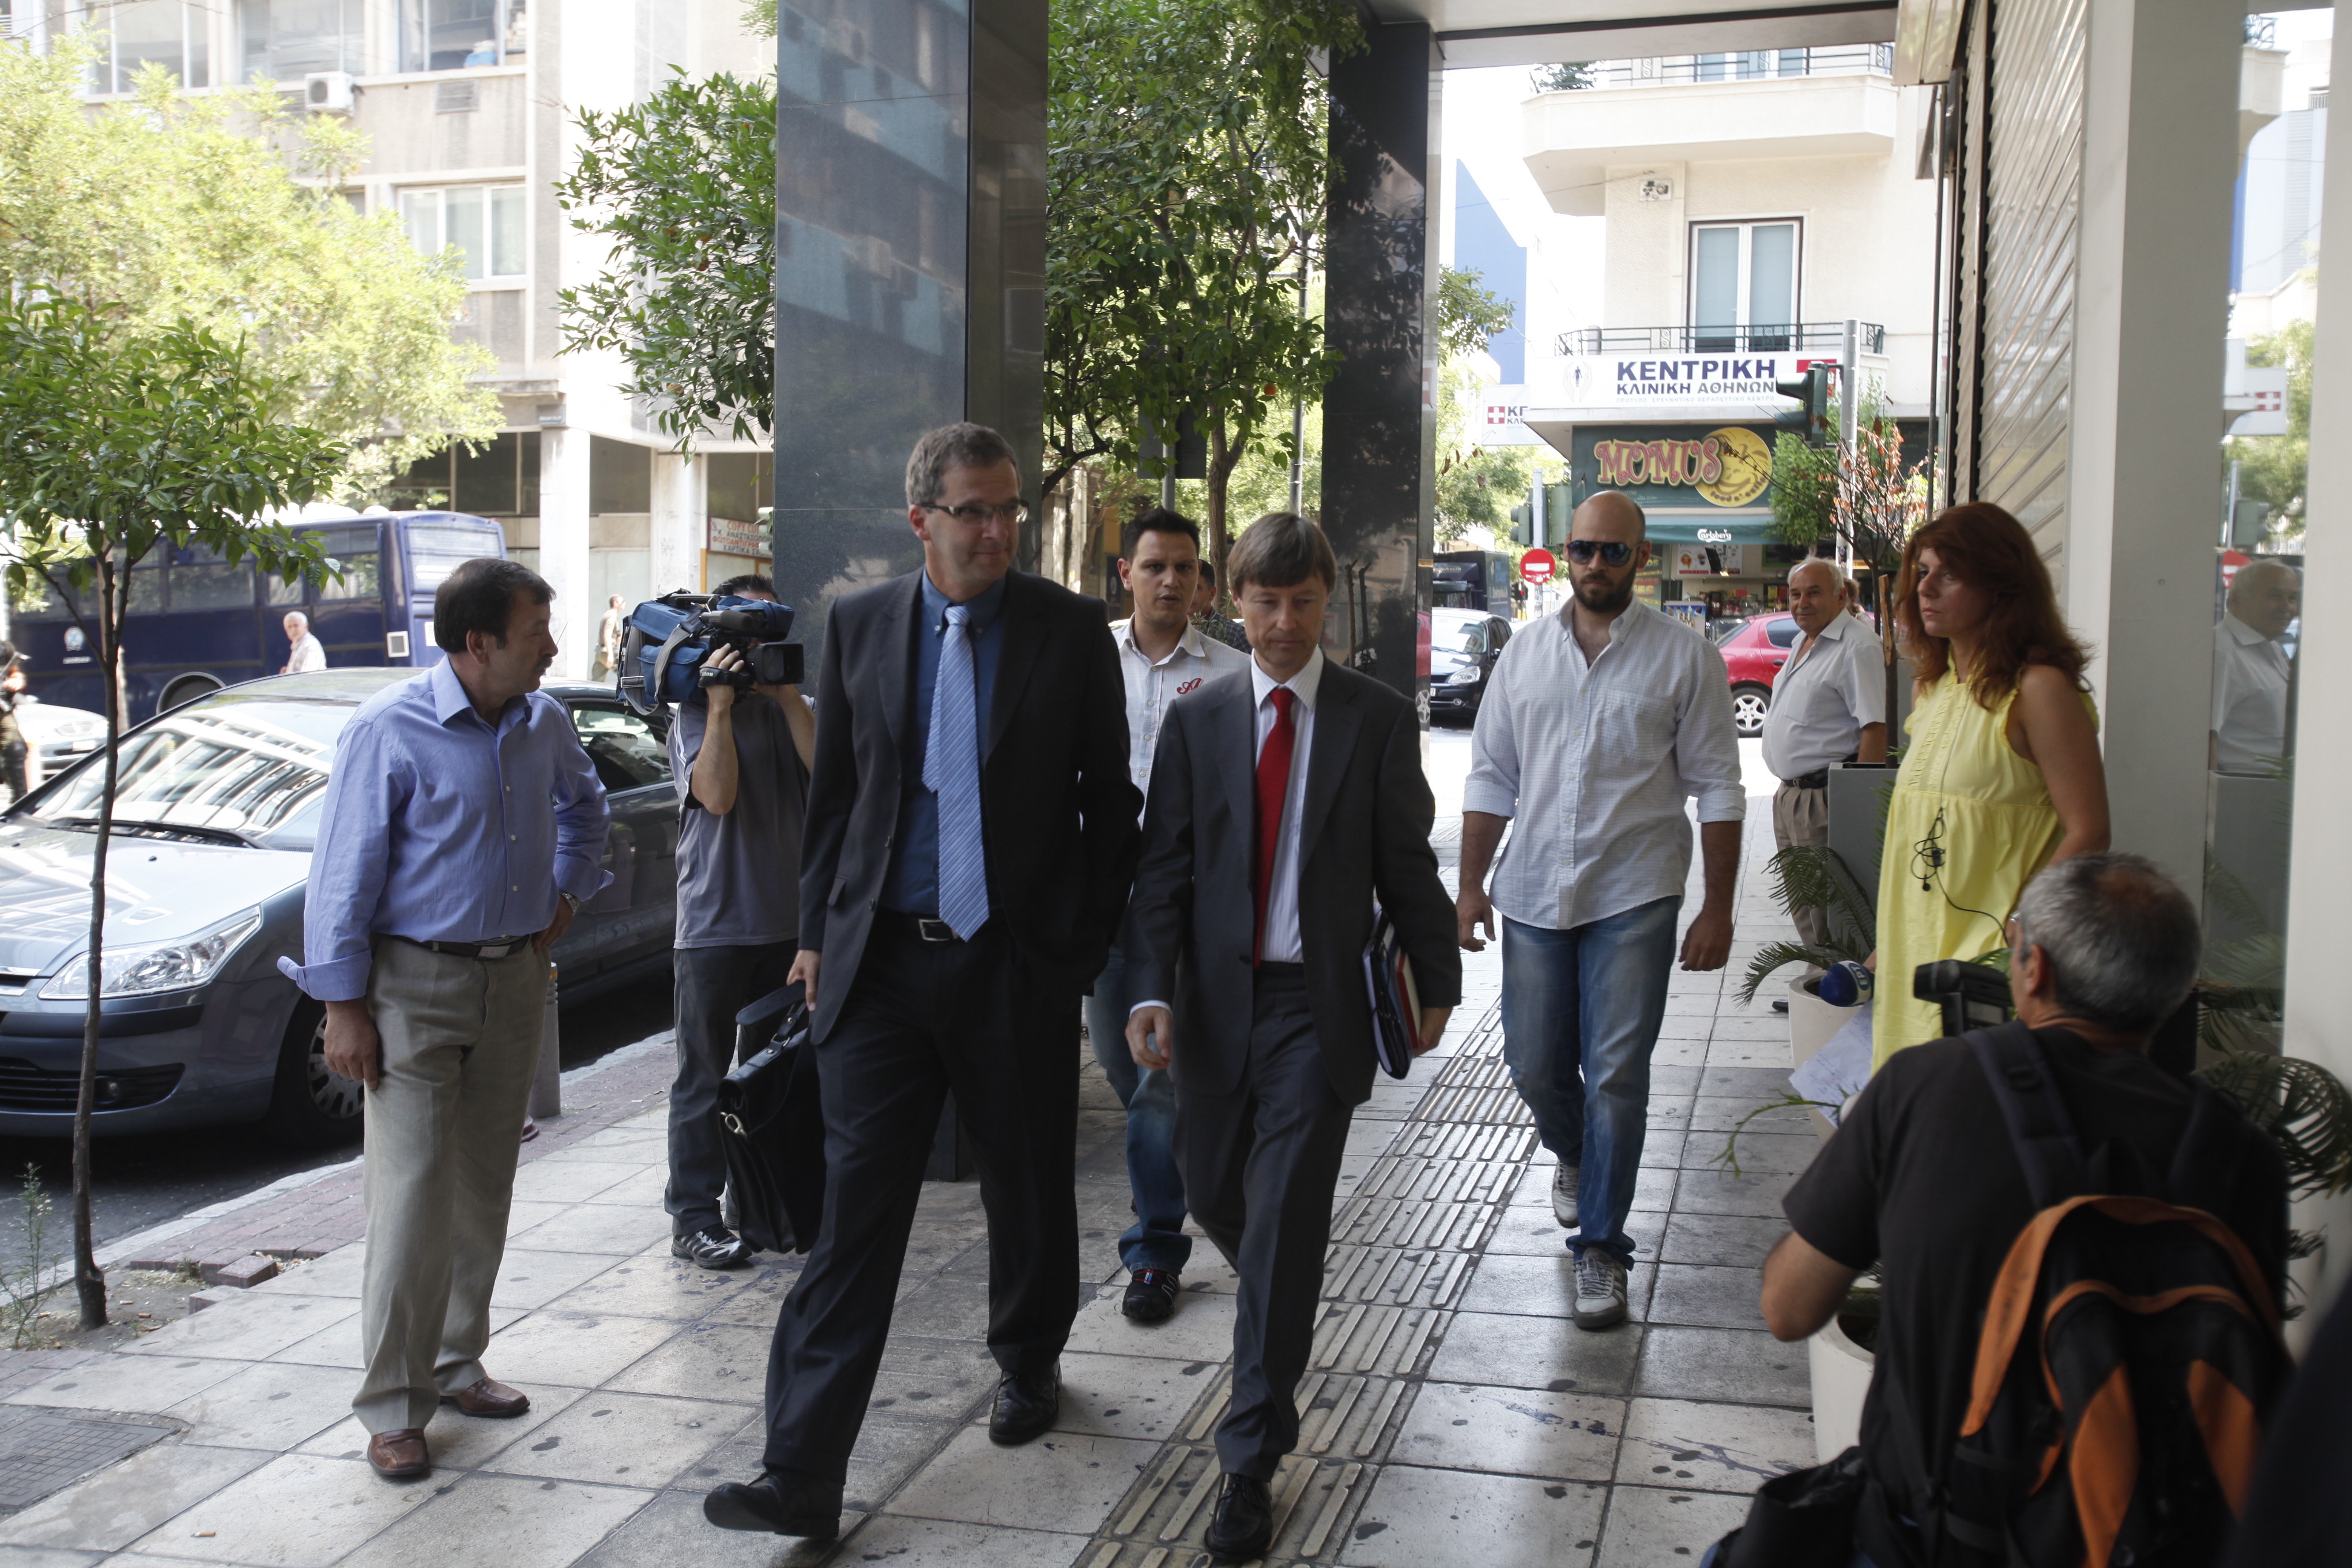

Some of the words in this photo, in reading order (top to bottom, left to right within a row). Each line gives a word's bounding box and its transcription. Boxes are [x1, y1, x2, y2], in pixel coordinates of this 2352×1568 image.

[1618, 359, 1776, 380] ΚΕΝΤΡΙΚΗ
[1616, 383, 1691, 395] ΚΛΙΝΙΚΗ
[1697, 381, 1774, 394] ΑΘΗΝΩΝ
[1595, 438, 1722, 486] MOMUS
[727, 520, 745, 532] COPY
[1697, 529, 1732, 543] Carlsberg
